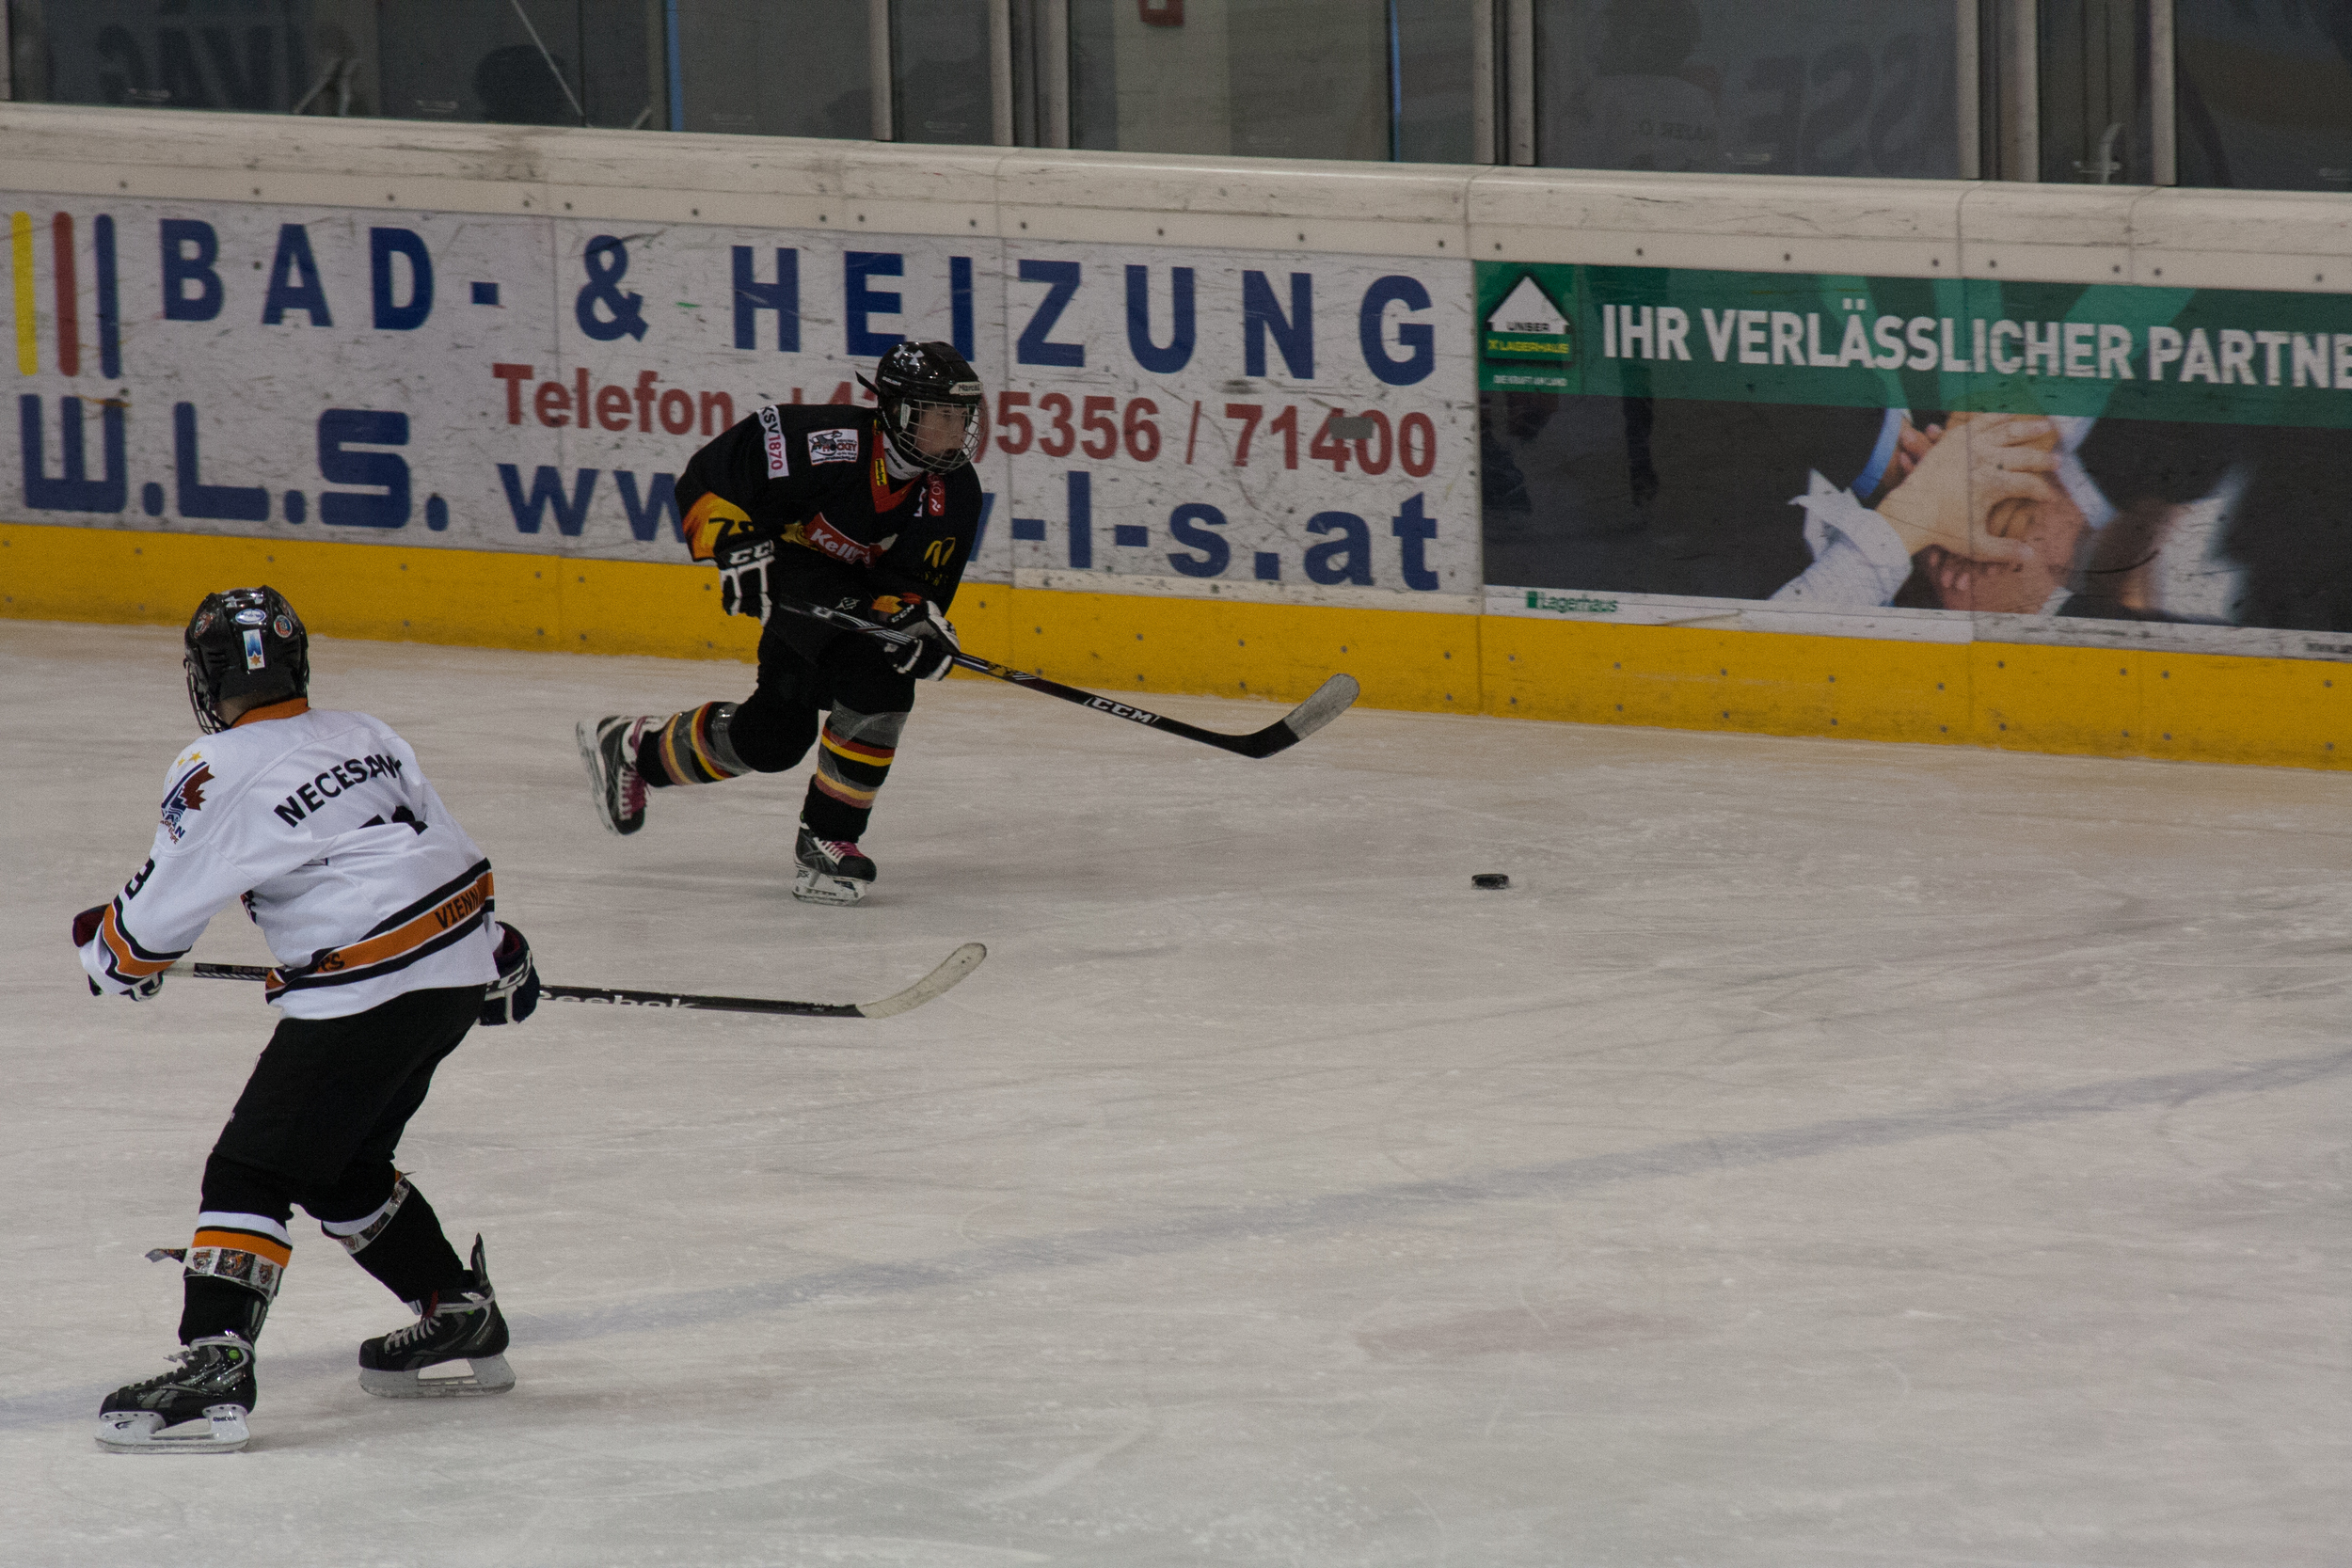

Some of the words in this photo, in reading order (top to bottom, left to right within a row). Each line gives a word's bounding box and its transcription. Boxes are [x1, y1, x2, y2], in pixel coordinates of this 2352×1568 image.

[575, 234, 649, 341] &
[731, 245, 1436, 387] HEIZUNG
[1602, 304, 1692, 361] IHR
[1701, 298, 2135, 380] VERLÄSSLICHER
[2149, 325, 2352, 389] PARTNE
[492, 362, 736, 437] Telefon
[1091, 696, 1155, 724] CCM
